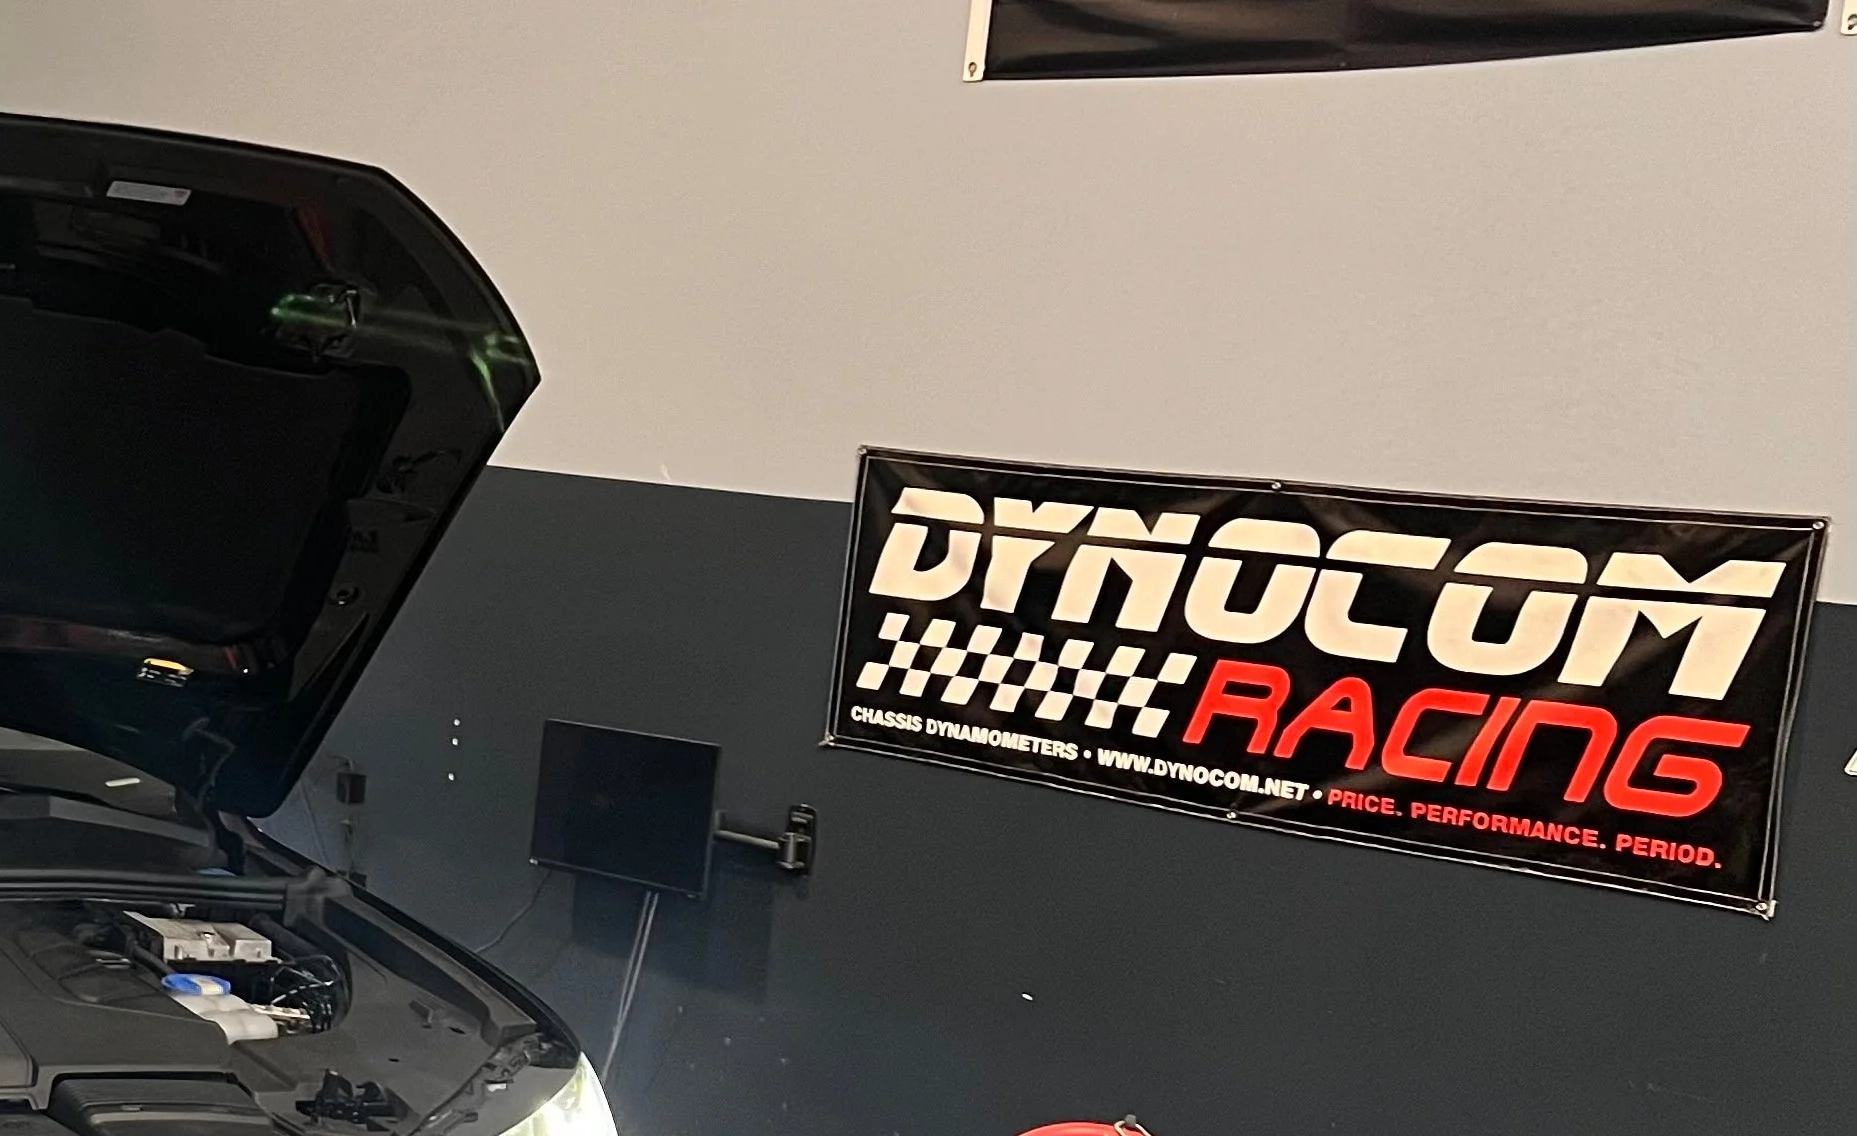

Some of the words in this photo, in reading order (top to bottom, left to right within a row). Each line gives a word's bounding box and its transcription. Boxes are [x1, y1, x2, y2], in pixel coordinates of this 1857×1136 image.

[869, 487, 1786, 701] DYNOCOM
[851, 705, 922, 732] CHASSIS
[926, 719, 1078, 761] DYNAMOMETERS
[1097, 748, 1310, 802] WWW.DYNOCOM.NET
[1327, 787, 1404, 817] PRICE.
[1410, 801, 1607, 849] PERFORMANCE.
[1615, 833, 1723, 869] PERIOD.
[1183, 660, 1750, 819] RACING
